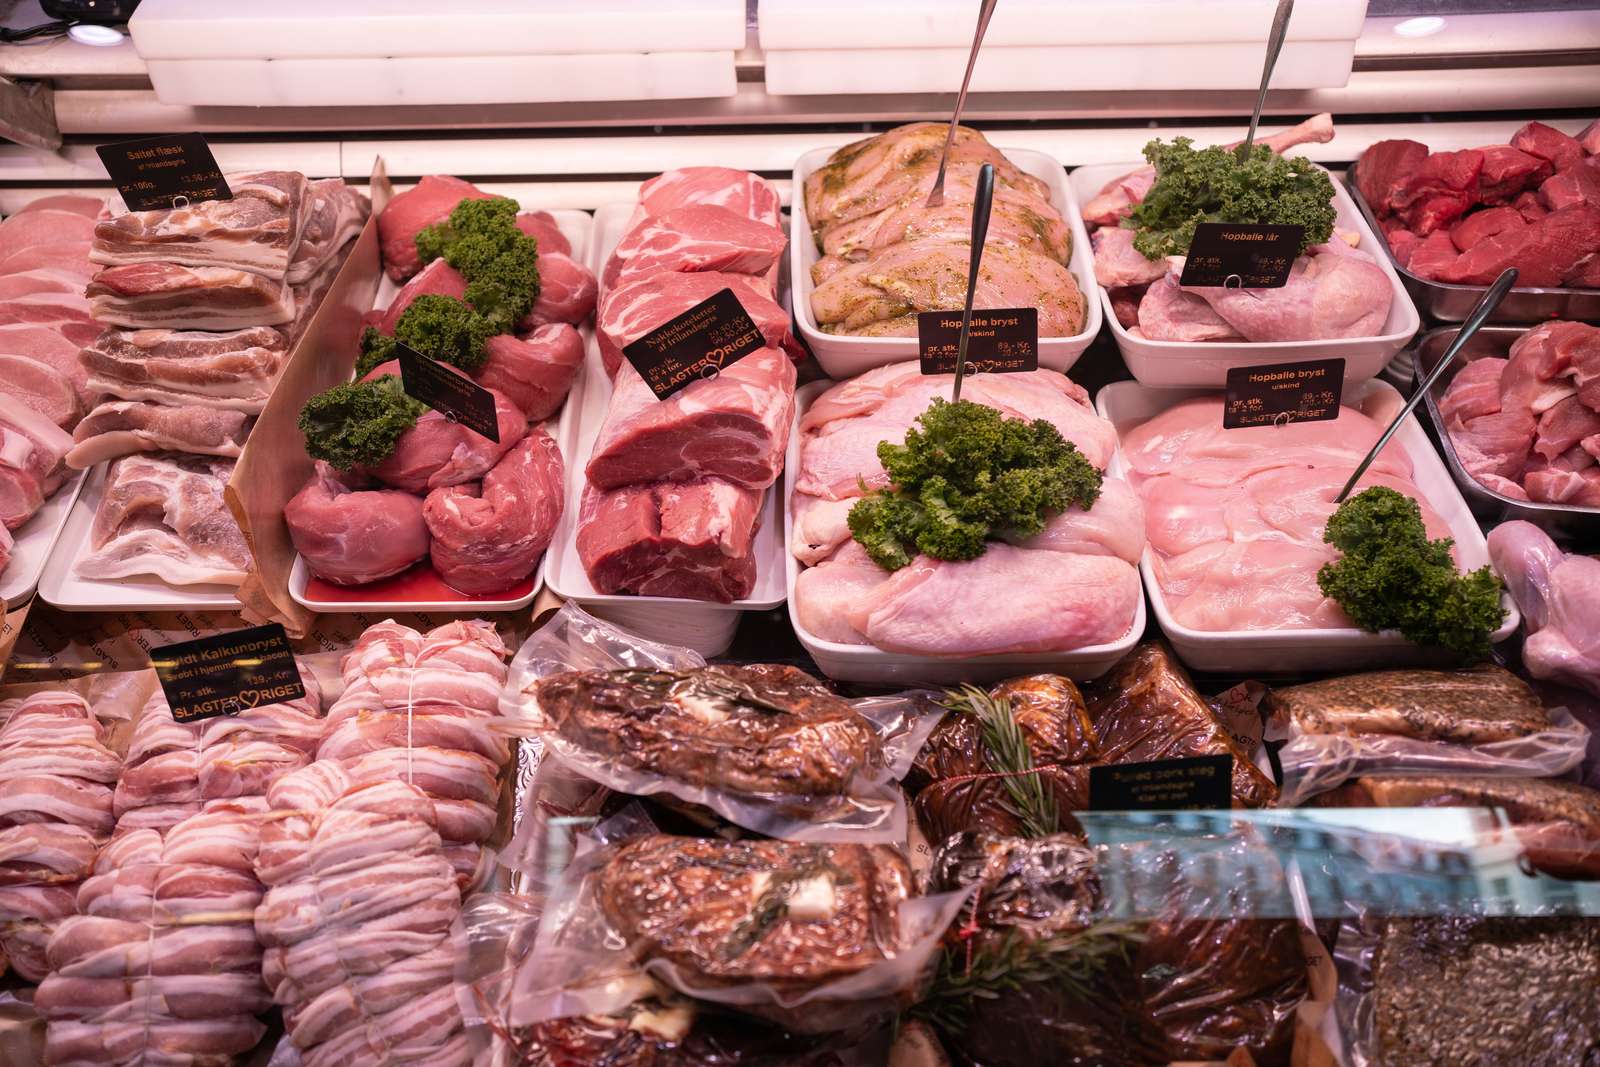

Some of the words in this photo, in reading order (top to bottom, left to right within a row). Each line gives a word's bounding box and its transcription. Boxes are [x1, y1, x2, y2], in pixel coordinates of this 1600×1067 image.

[940, 318, 988, 329] Hopalle
[990, 316, 1019, 327] bryst
[654, 359, 708, 394] SLAGTER
[723, 328, 761, 355] RIGET
[1248, 371, 1295, 382] Hopballe
[1298, 368, 1325, 379] bryst
[175, 696, 240, 718] SLAGTER
[260, 682, 302, 699] RIGET
